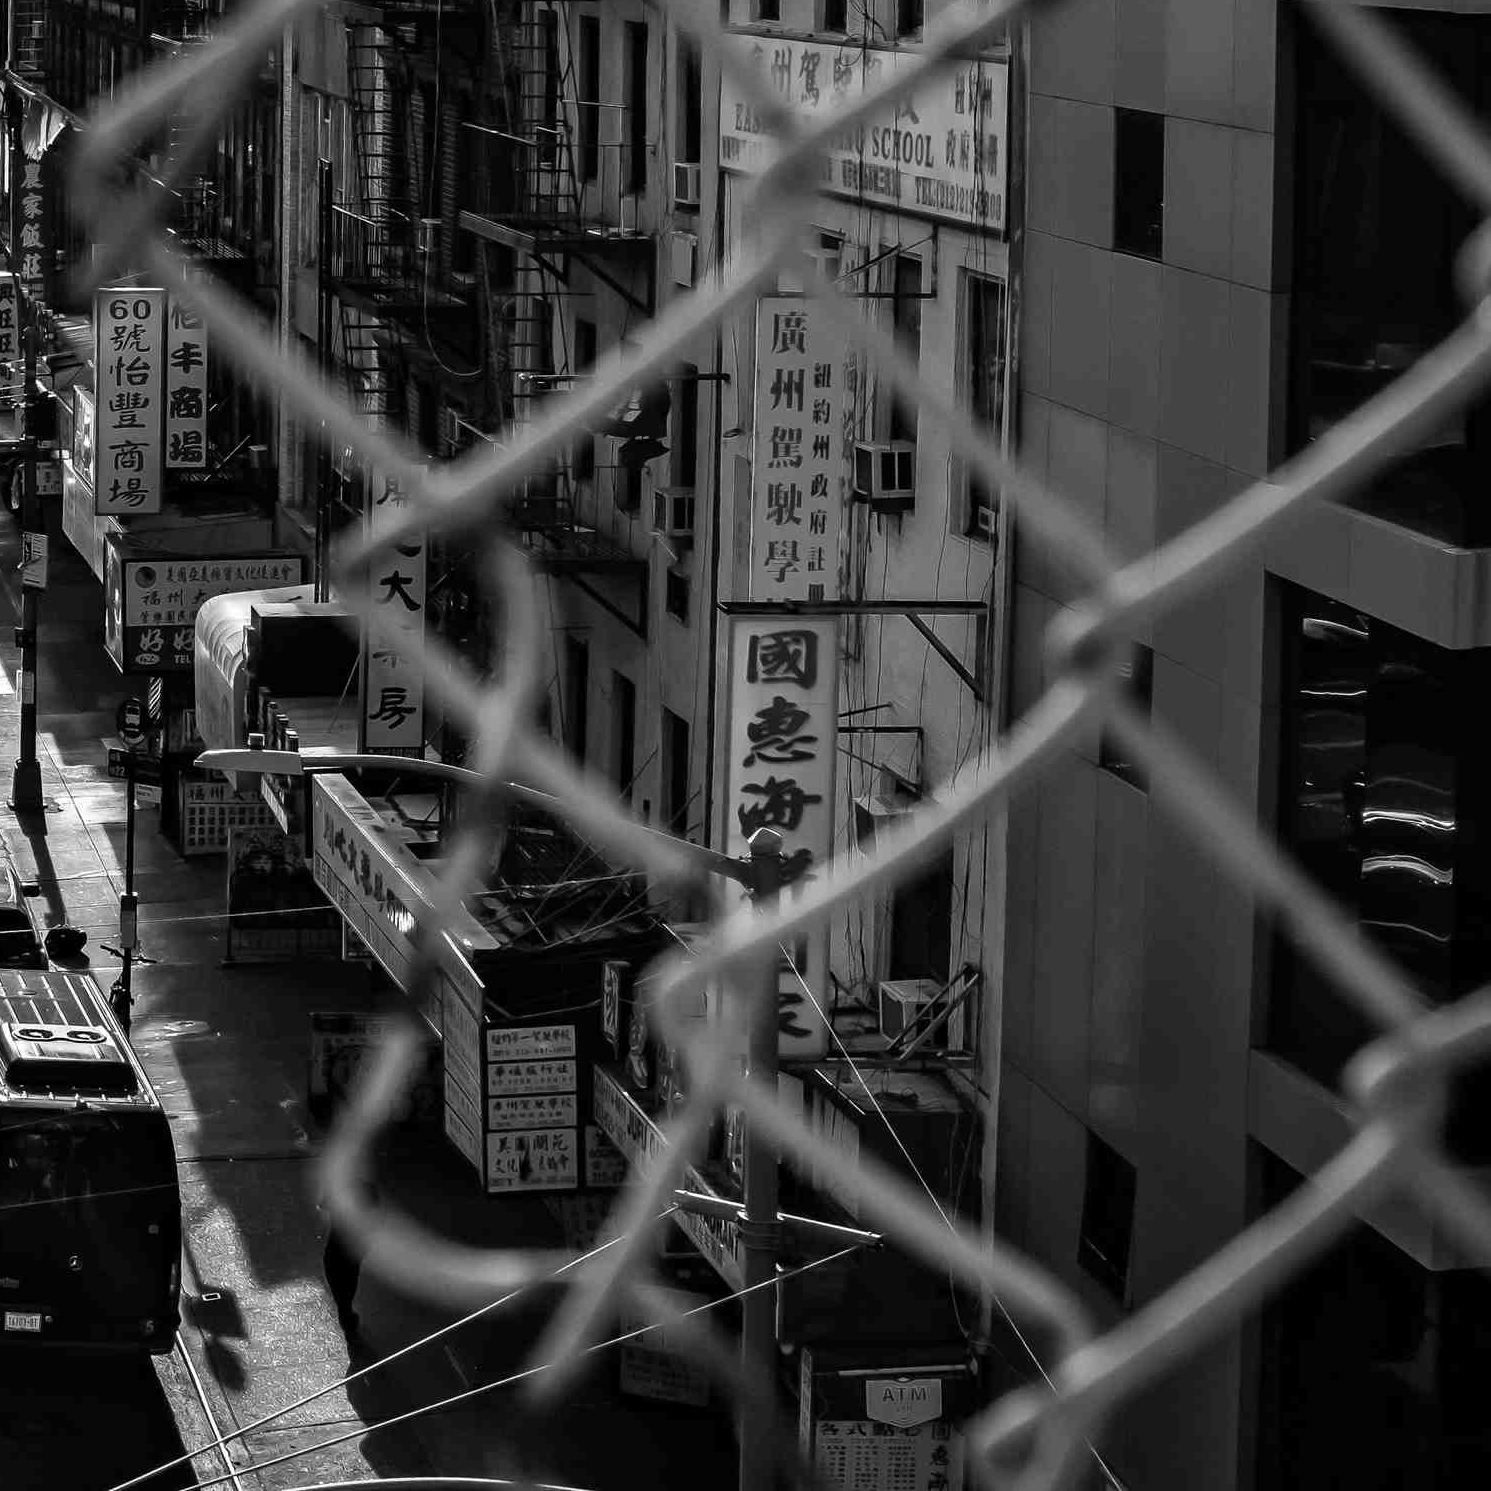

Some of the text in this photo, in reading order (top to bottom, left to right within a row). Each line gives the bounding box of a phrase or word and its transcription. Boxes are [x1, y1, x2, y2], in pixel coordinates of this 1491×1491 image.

[872, 126, 934, 168] SCHOOL
[764, 311, 809, 602] 廣州駕駛學
[882, 1387, 927, 1402] ATM
